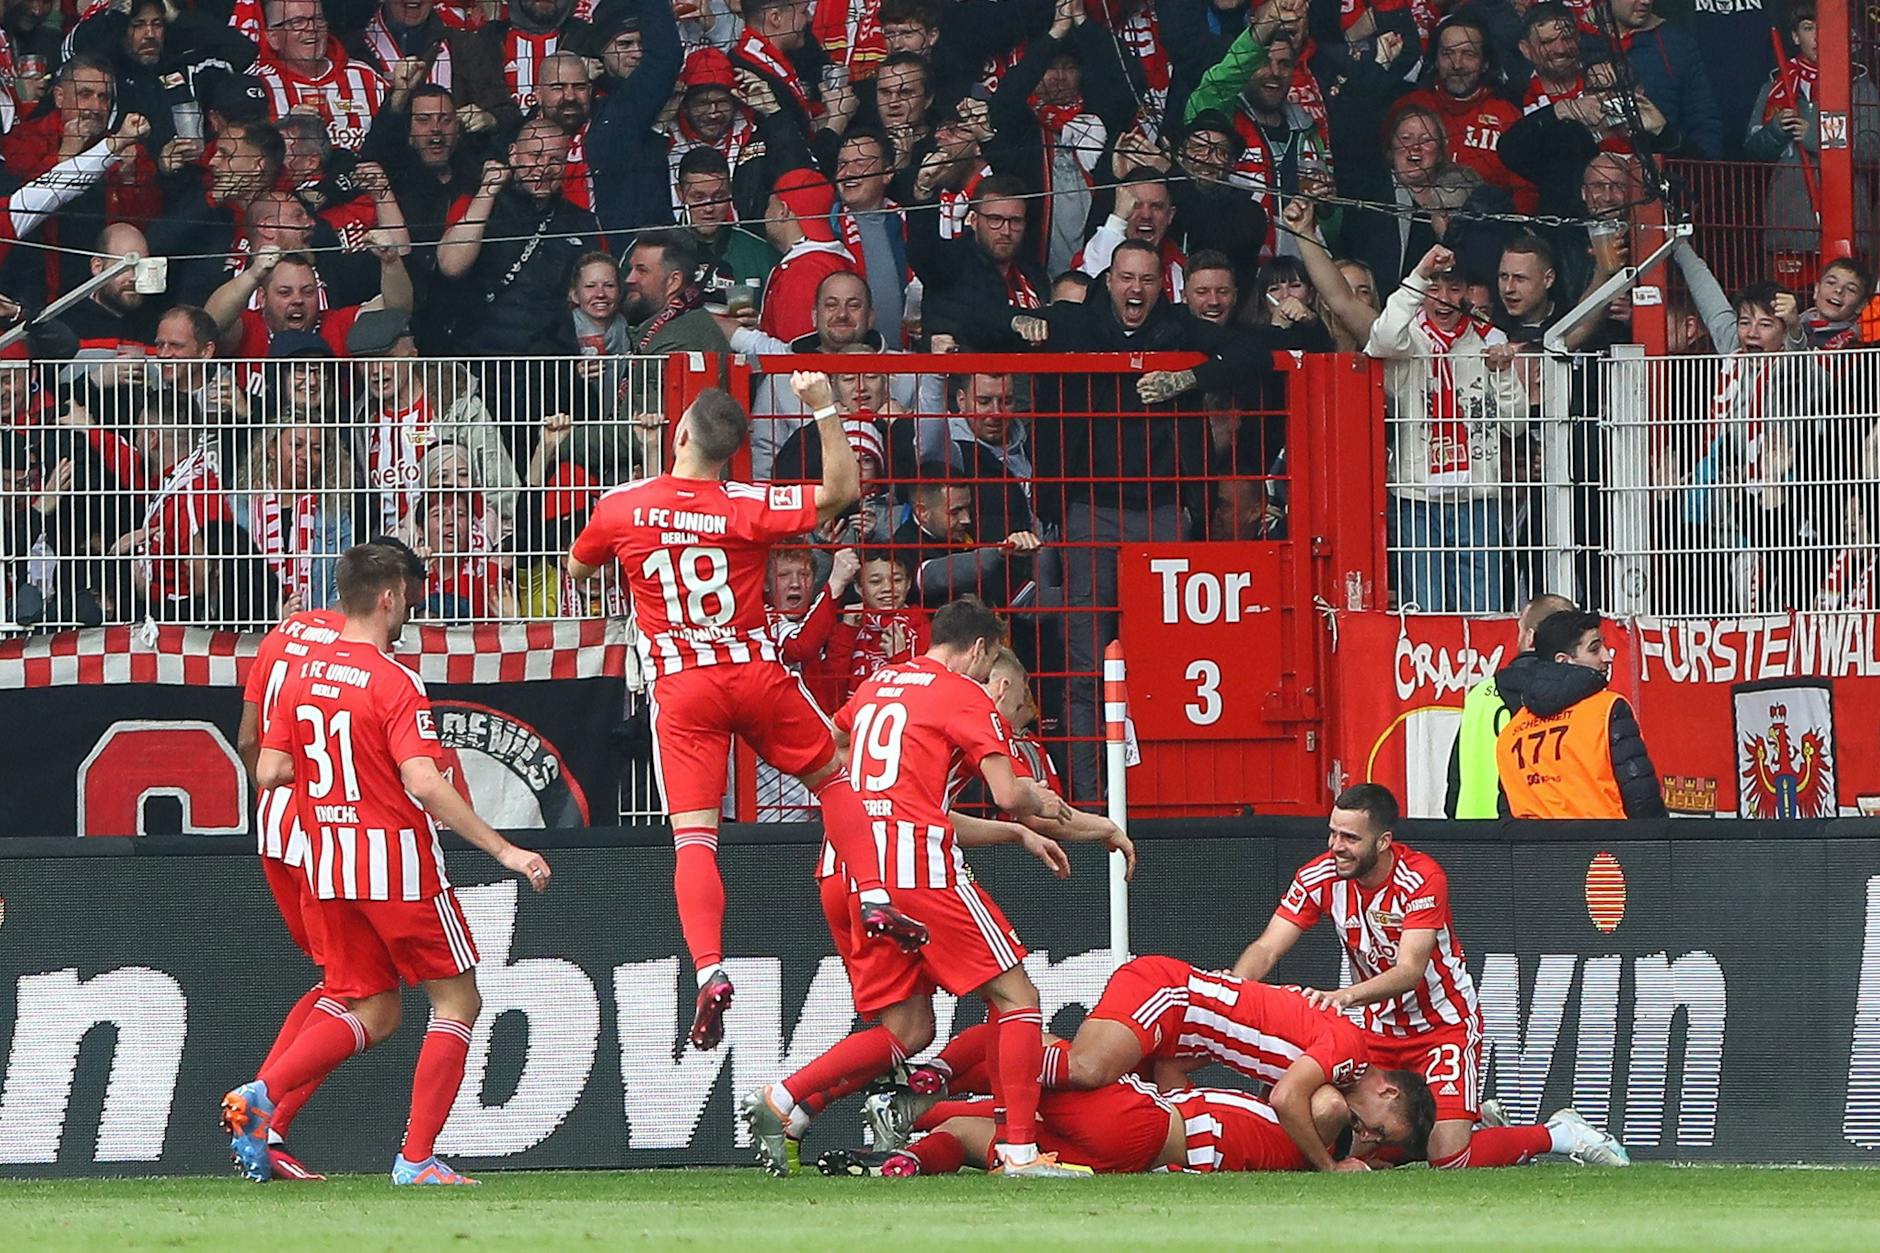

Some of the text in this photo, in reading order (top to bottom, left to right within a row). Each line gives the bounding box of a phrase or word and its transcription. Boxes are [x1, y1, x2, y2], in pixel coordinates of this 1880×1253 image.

[326, 120, 366, 150] fox
[633, 508, 727, 534] 1. FC UNION
[660, 532, 699, 545] BERLIN
[642, 547, 736, 627] 18
[1151, 559, 1251, 624] Tor
[285, 621, 306, 638] FC
[301, 626, 340, 645] UNION
[309, 660, 327, 679] FC
[325, 664, 371, 689] UNION
[895, 672, 937, 687] UNION
[1395, 638, 1505, 700] CRAZY
[310, 682, 341, 699] BERLIN
[1185, 659, 1224, 726] 3
[295, 704, 361, 802] 31
[850, 702, 908, 793] 19
[1511, 725, 1569, 770] 177
[1425, 1043, 1462, 1085] 23
